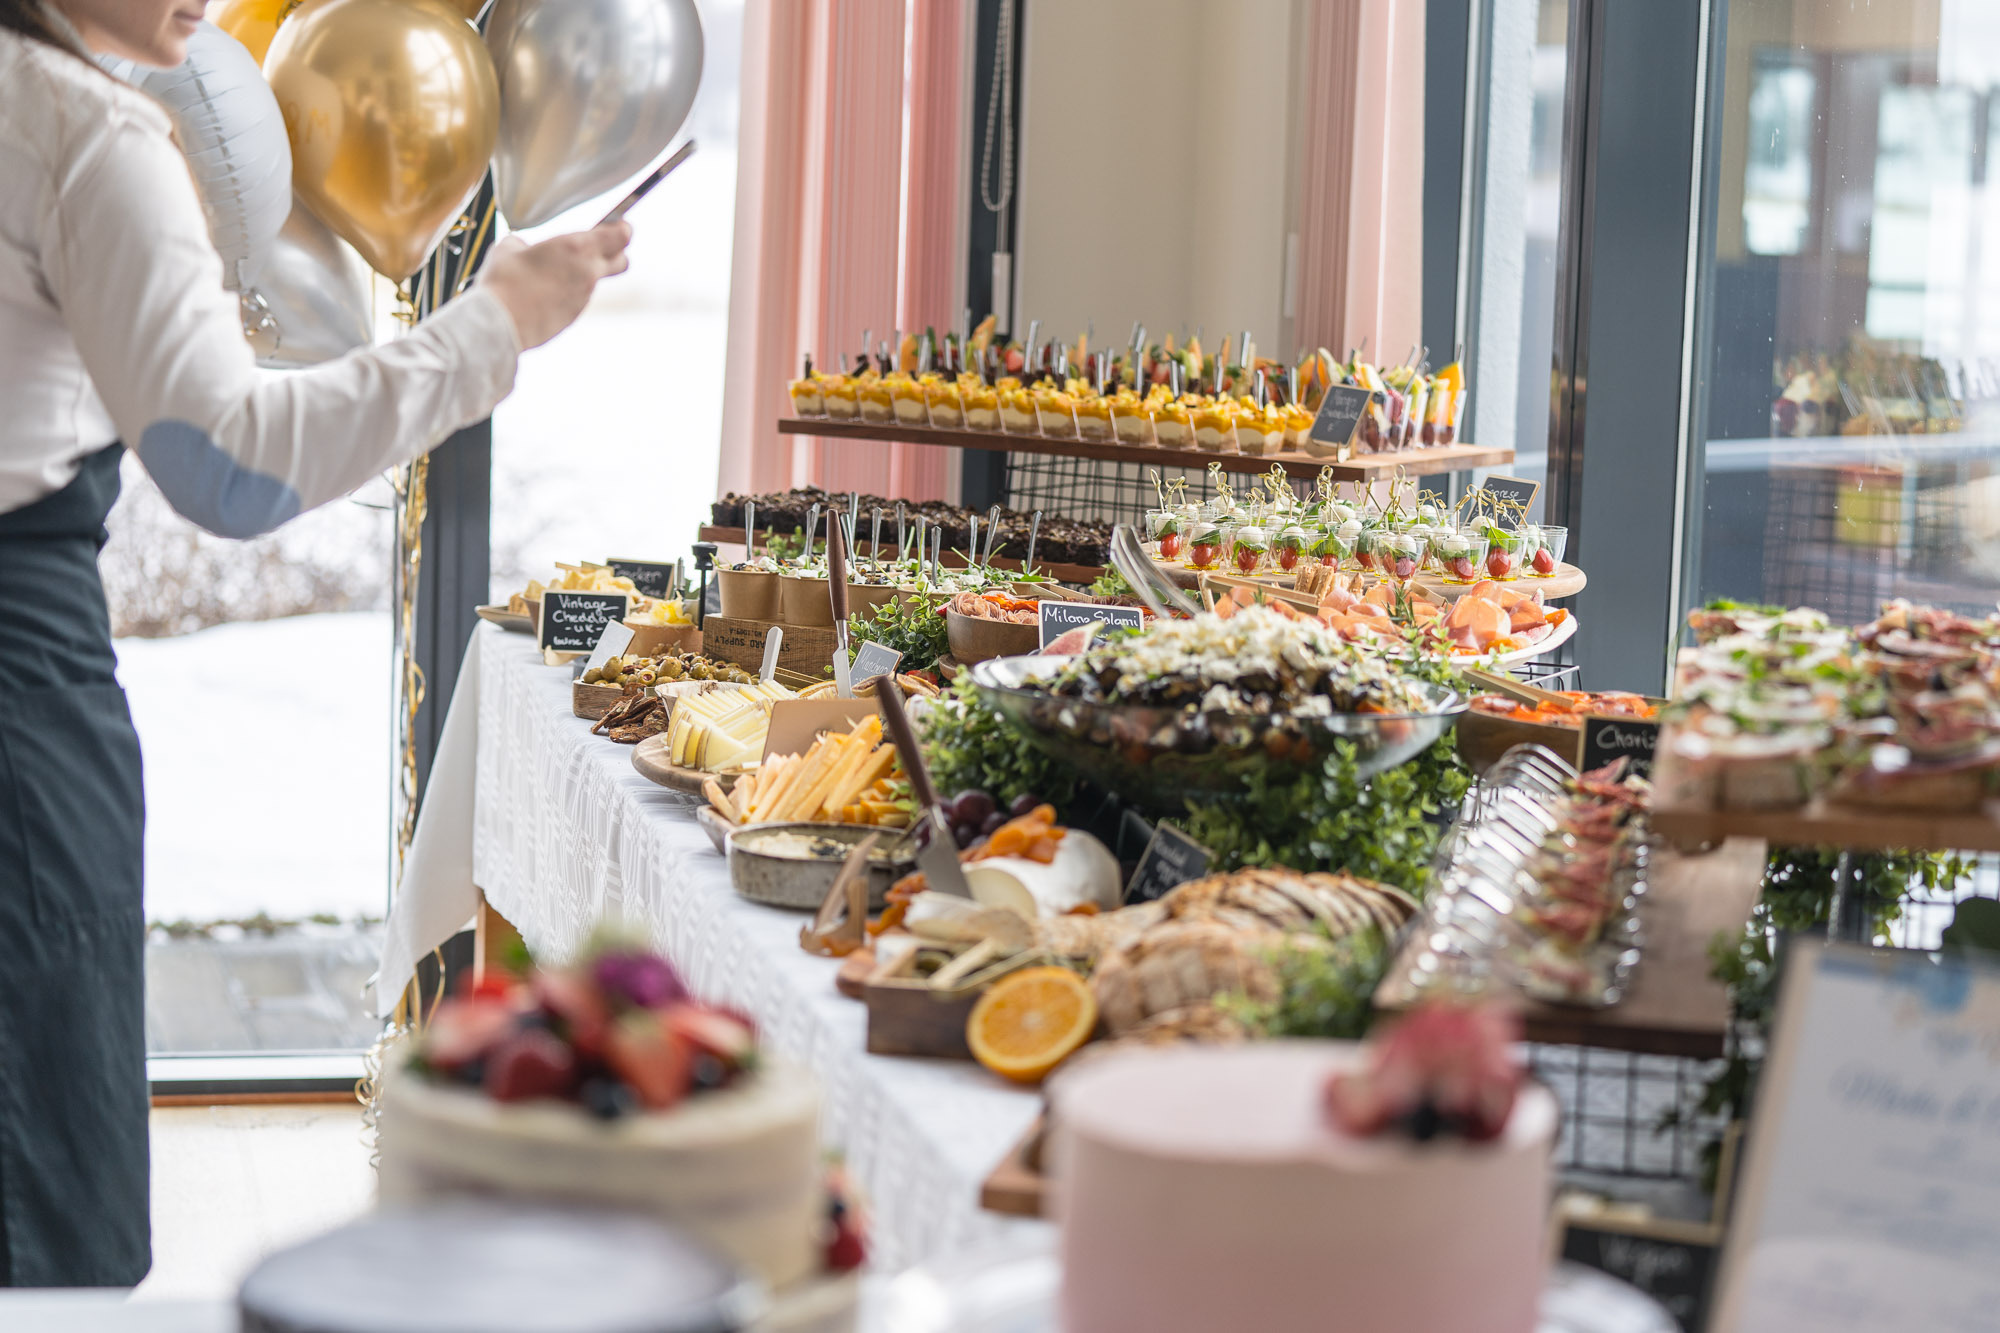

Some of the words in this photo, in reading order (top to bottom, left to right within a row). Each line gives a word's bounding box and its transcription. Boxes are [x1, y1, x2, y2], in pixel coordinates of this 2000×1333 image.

[559, 594, 619, 617] Vintage
[552, 609, 617, 624] Cheddar
[1044, 606, 1090, 624] Milano
[1093, 610, 1139, 627] Salami
[714, 635, 745, 647] SUPPLY
[750, 640, 790, 652] STARD
